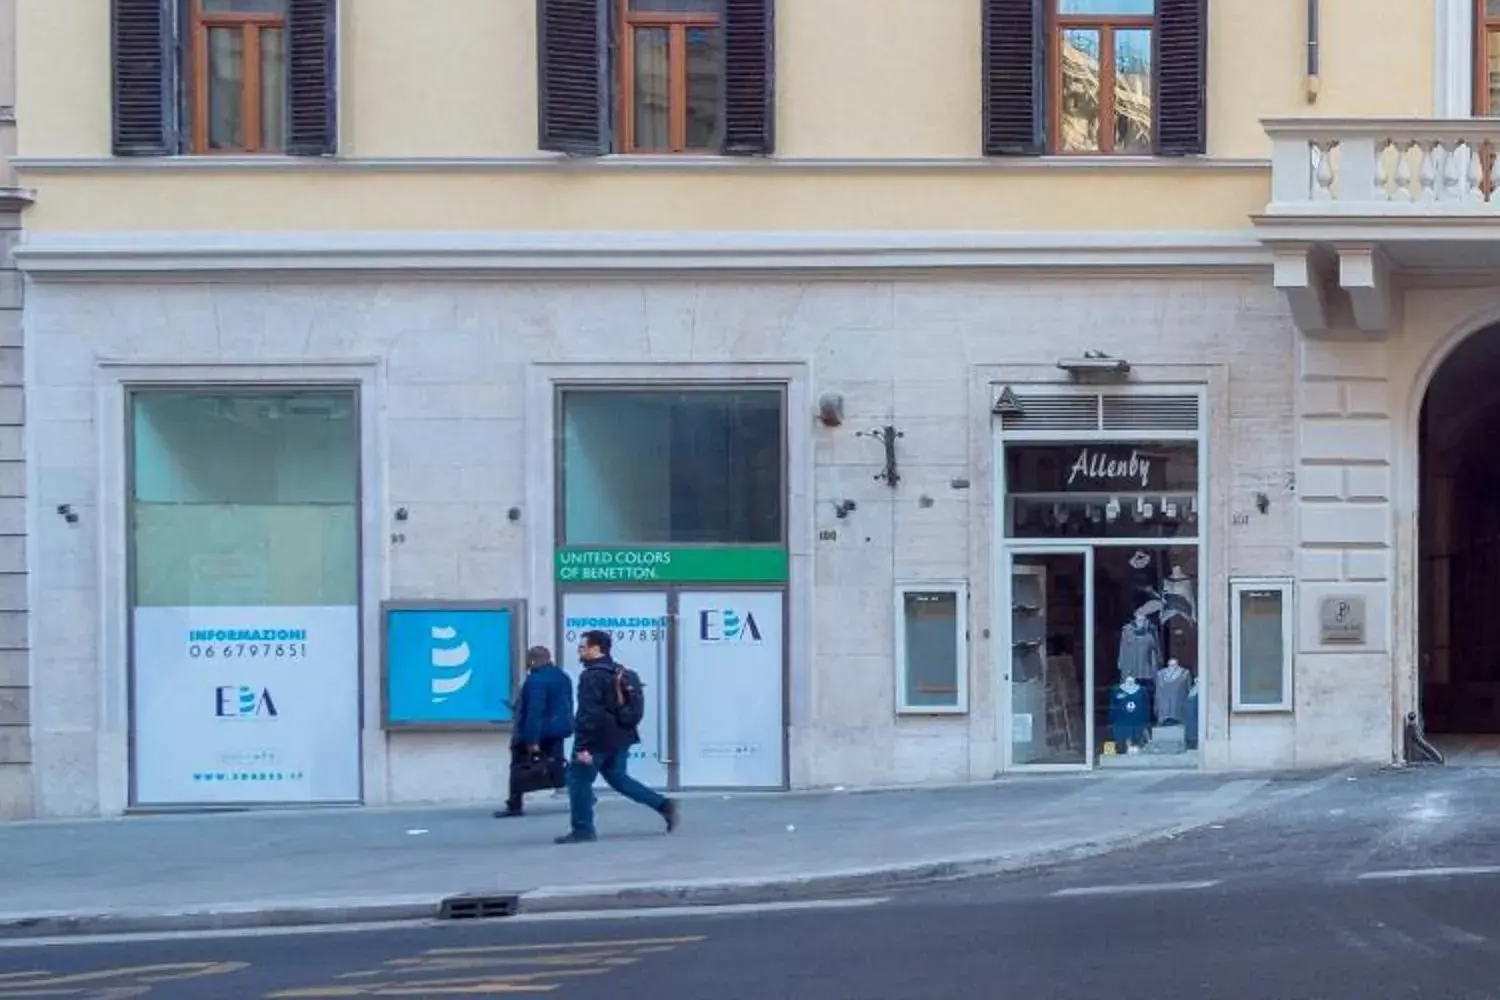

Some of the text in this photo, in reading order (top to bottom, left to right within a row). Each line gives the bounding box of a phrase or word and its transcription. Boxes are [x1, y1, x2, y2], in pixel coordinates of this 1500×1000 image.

[1068, 447, 1150, 487] Allenby
[561, 551, 670, 564] UNITED COLORS
[560, 567, 579, 579] OF
[189, 629, 307, 641] INFORMAZIONI
